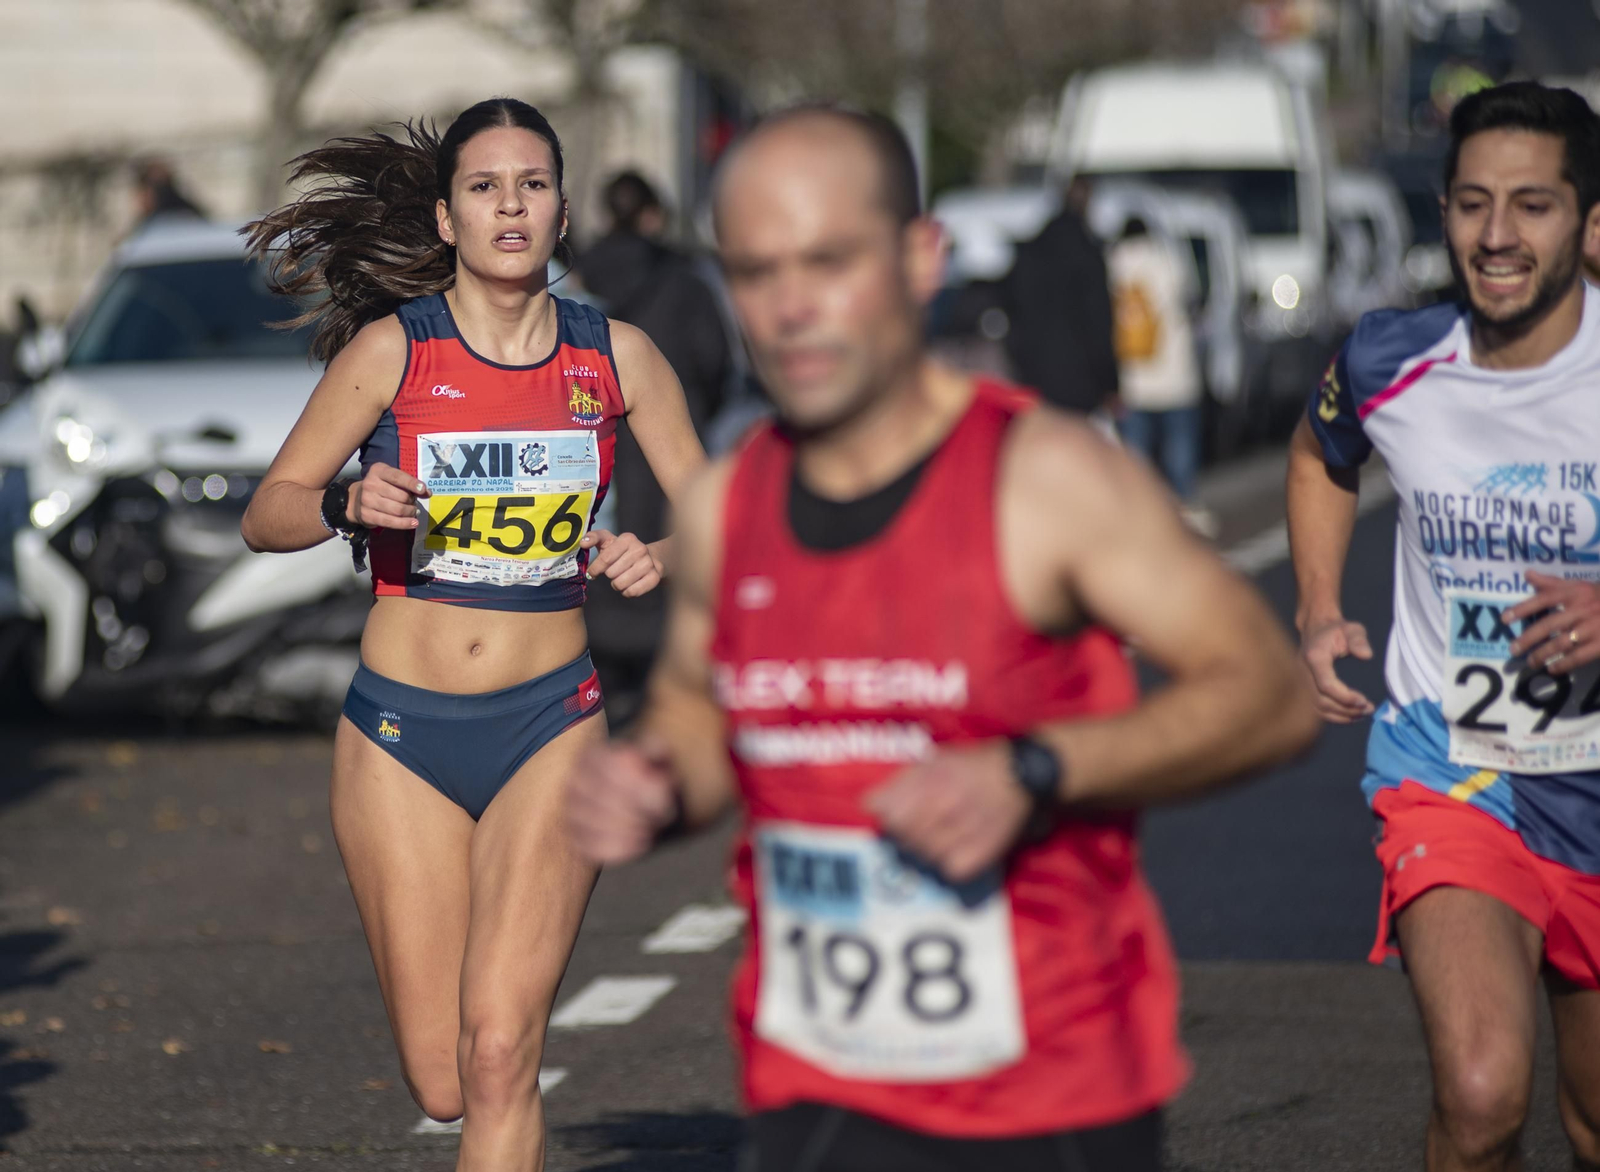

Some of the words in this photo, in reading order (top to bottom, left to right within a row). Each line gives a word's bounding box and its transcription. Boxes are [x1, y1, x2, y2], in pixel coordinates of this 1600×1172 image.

[571, 364, 589, 372] CLUB
[571, 415, 604, 426] ATLETISMO
[428, 442, 513, 478] XXII
[1558, 462, 1597, 491] 15K
[427, 479, 467, 487] CARREIRA
[486, 478, 514, 486] NADAL
[430, 494, 583, 555] 456
[1413, 488, 1541, 525] NOCTURNA
[1418, 514, 1579, 565] OURENSE
[816, 658, 968, 709] TEAM
[786, 926, 973, 1024] 198
